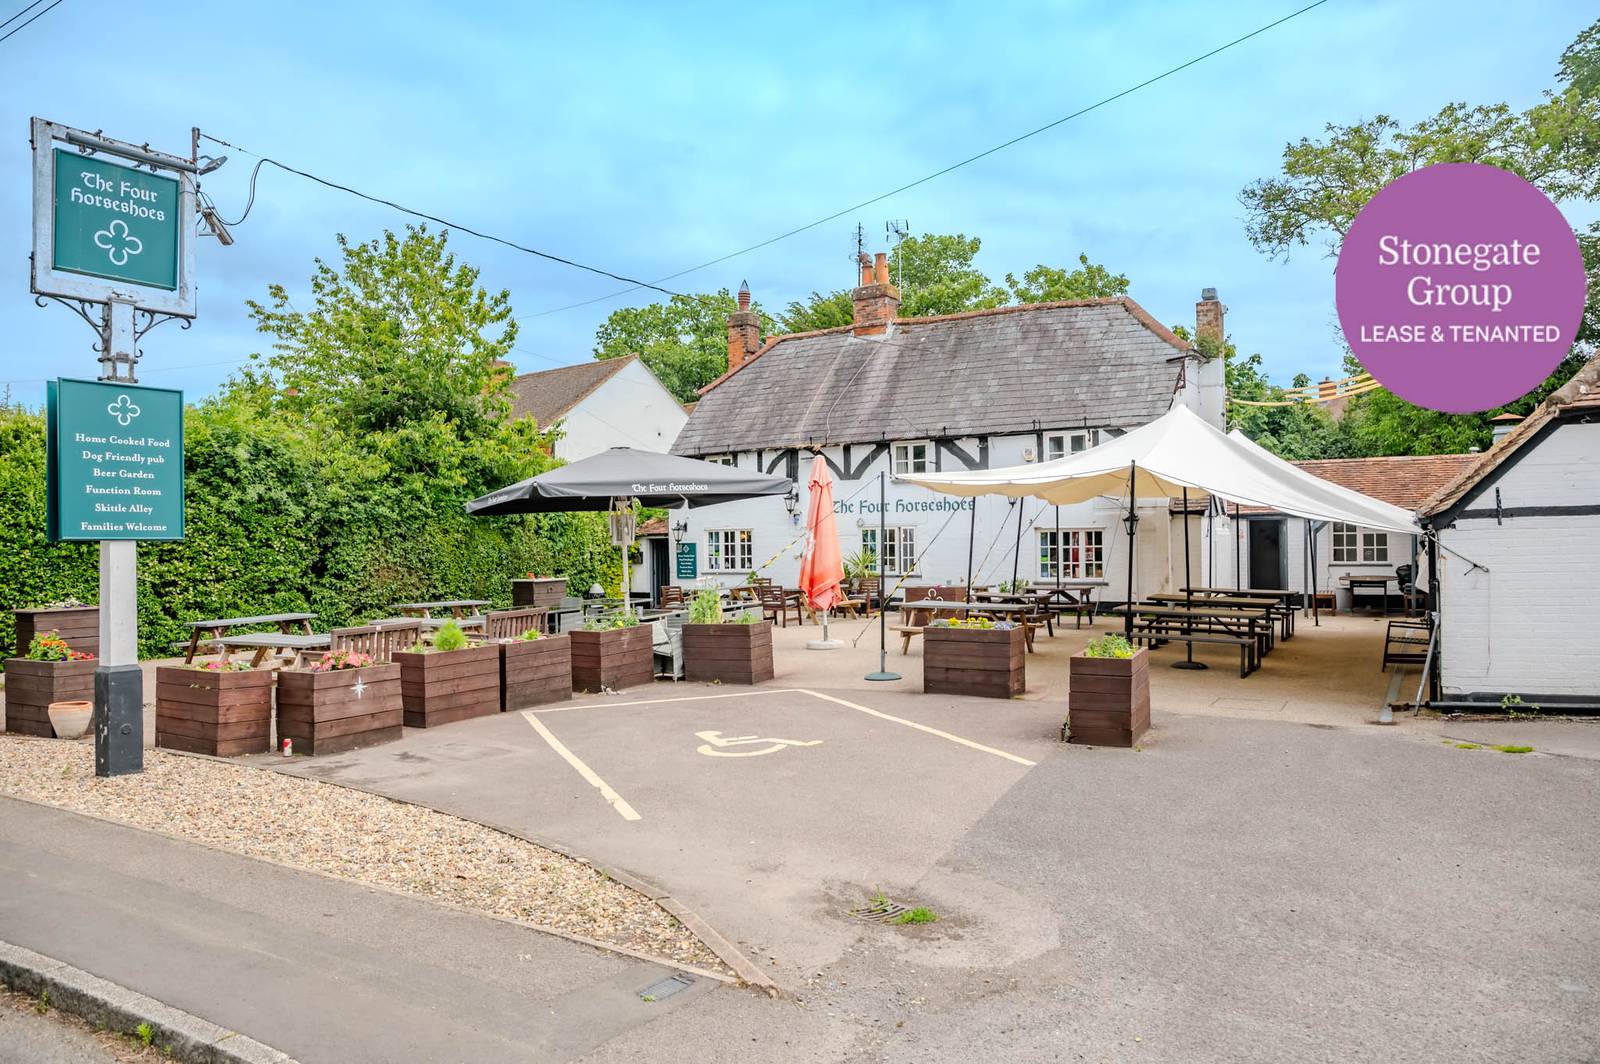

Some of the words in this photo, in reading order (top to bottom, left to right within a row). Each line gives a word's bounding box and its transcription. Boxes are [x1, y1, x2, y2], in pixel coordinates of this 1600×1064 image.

[80, 171, 114, 192] The
[120, 181, 158, 202] Four
[71, 187, 165, 221] Horseshoes
[75, 433, 107, 444] Home
[109, 436, 145, 446] Cooked
[147, 438, 170, 448] Food
[82, 451, 103, 461] Dog
[105, 452, 146, 464] Friendly
[147, 455, 165, 465] pub
[93, 468, 117, 478] Beer
[119, 469, 154, 479] Garden
[86, 485, 131, 495] Function
[133, 487, 162, 496] Room
[632, 483, 647, 492] The
[649, 483, 667, 492] Four
[94, 503, 127, 513] Skittle
[129, 504, 153, 515] Alley
[832, 499, 855, 514] The
[80, 522, 124, 531] Families
[125, 523, 168, 532] Welcome
